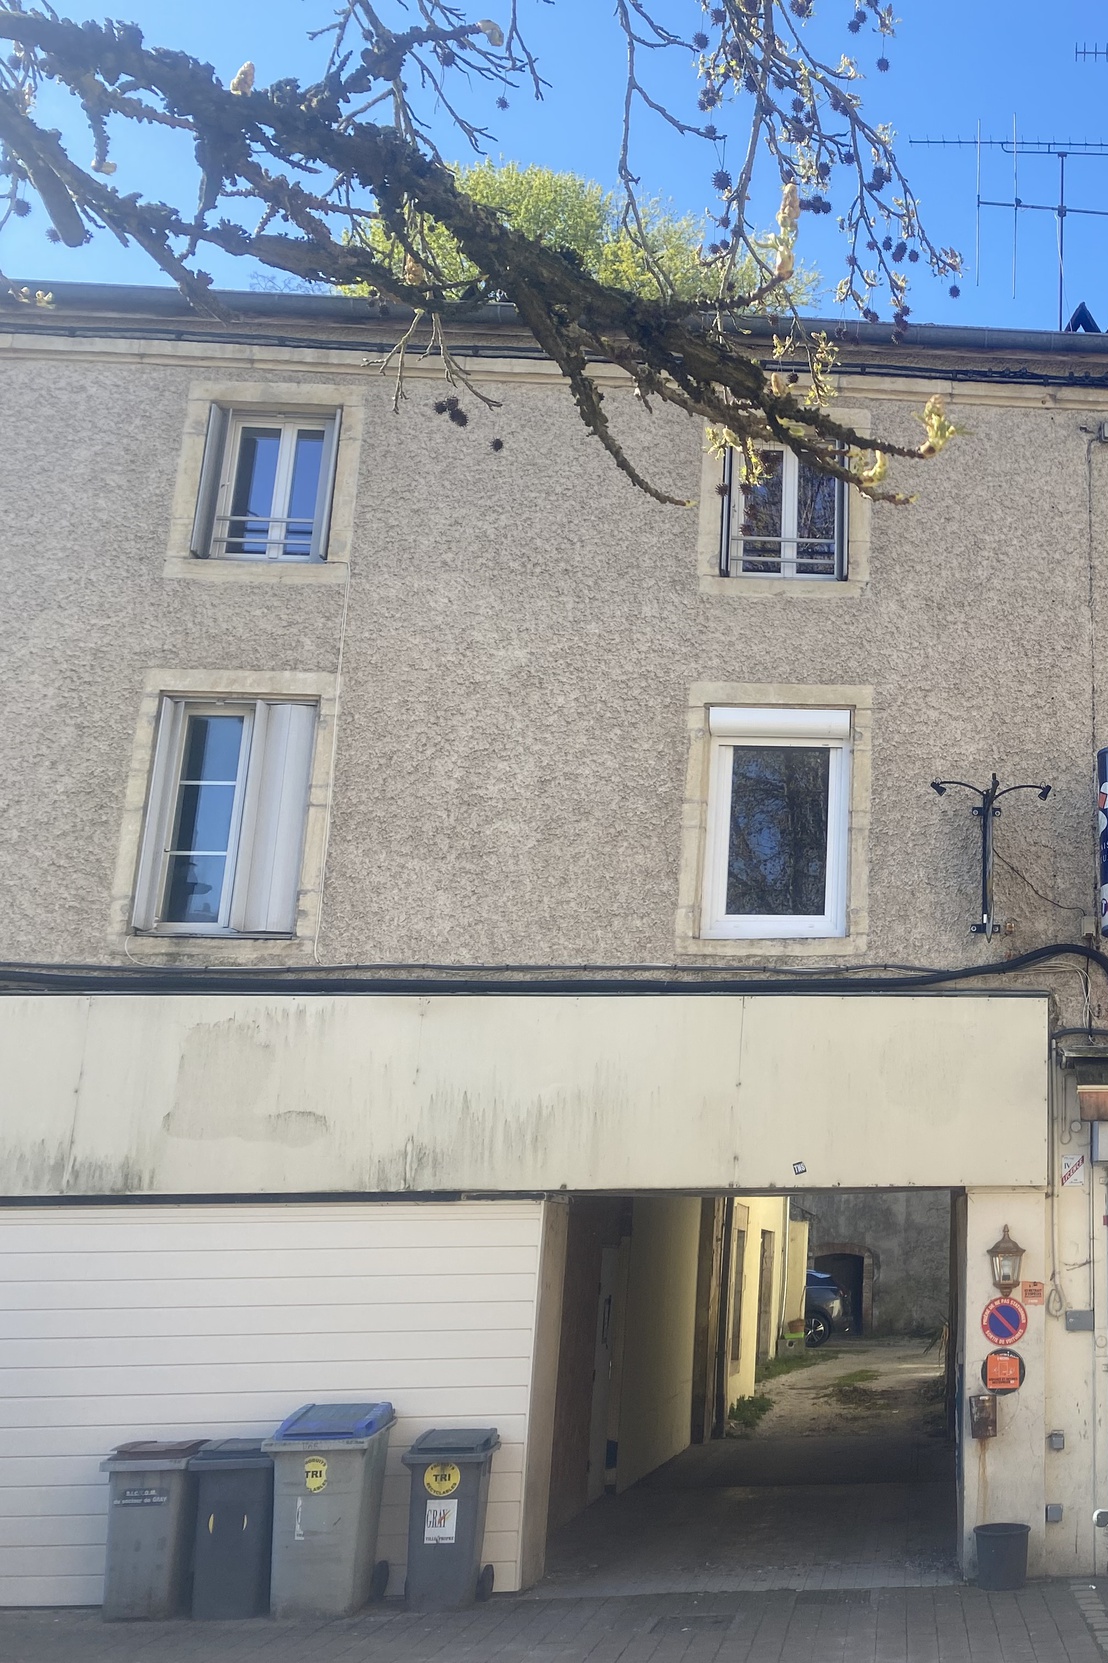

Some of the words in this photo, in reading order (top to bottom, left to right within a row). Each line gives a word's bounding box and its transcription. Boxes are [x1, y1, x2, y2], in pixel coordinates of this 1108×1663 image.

[1062, 1155, 1084, 1186] LICENCE
[305, 1470, 323, 1479] TRI
[433, 1473, 451, 1482] TRI
[426, 1482, 457, 1495] RECYCLABLES
[427, 1509, 448, 1528] GRAY
